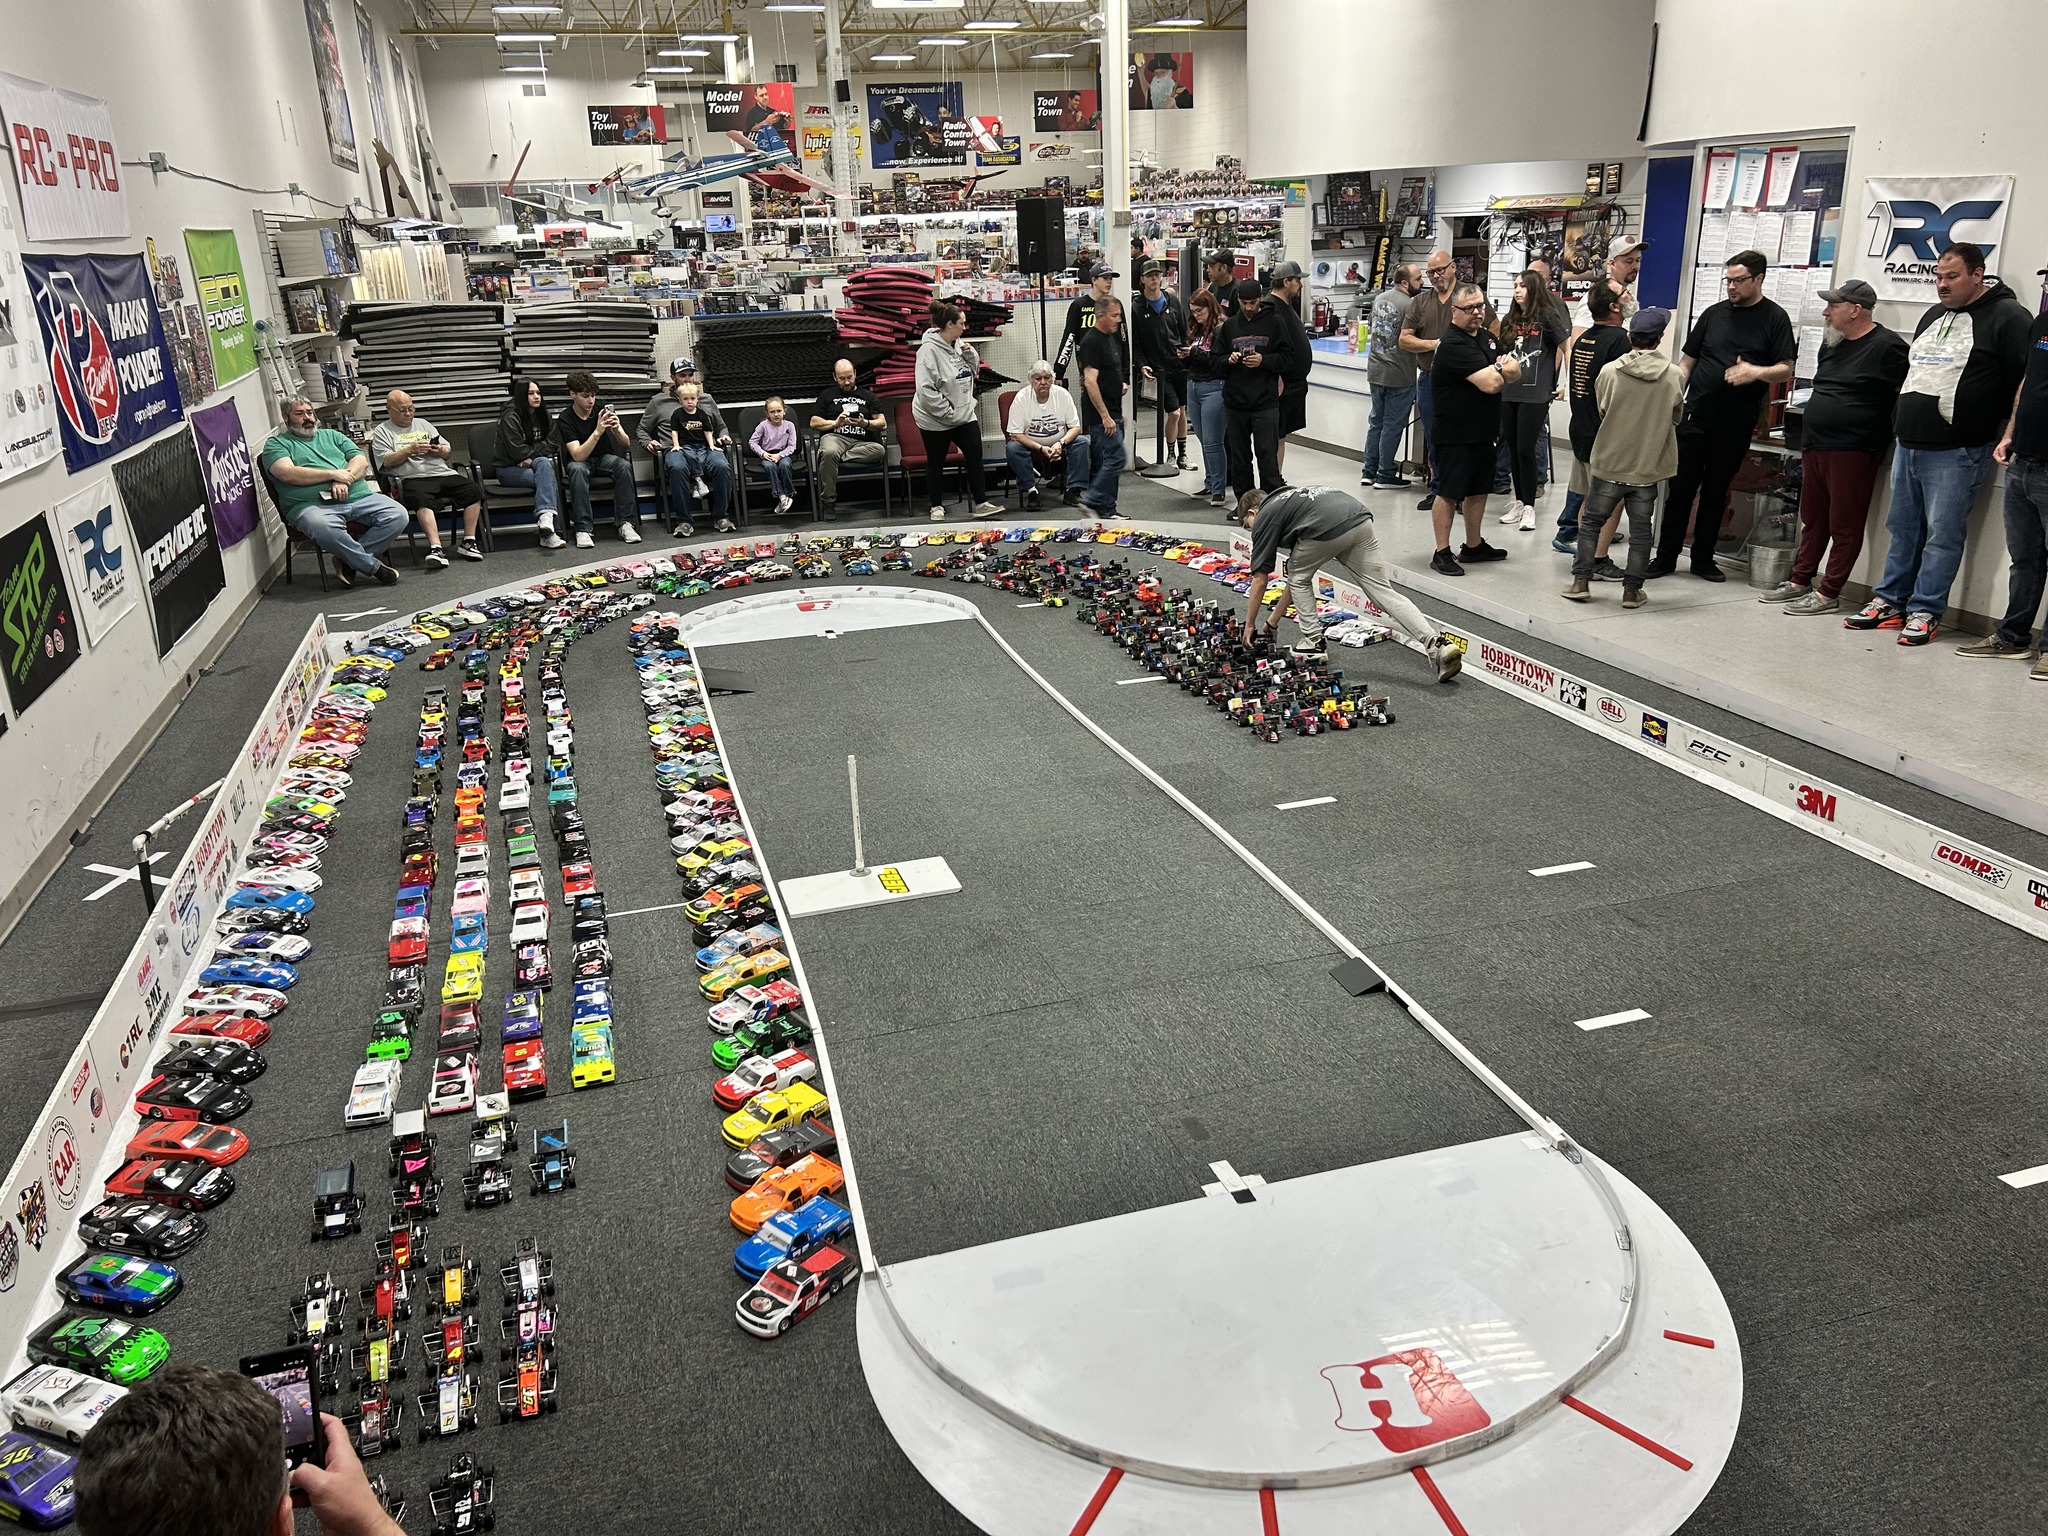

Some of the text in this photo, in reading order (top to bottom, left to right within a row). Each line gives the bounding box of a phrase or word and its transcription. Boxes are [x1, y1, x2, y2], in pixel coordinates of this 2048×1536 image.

[706, 90, 743, 102] Model
[870, 87, 896, 95] You've
[899, 86, 935, 94] Dreamed
[708, 102, 740, 114] Town
[1036, 97, 1058, 107] Tool
[591, 111, 609, 124] Toy
[1038, 106, 1063, 117] Town
[592, 121, 619, 131] Town
[943, 121, 967, 130] Radio
[943, 130, 973, 138] Control
[944, 138, 966, 147] Town
[12, 122, 120, 193] RC-PRO
[909, 157, 953, 165] Experience
[199, 273, 243, 312] ECO
[206, 303, 249, 335] POWER
[1081, 313, 1097, 329] 10
[67, 504, 122, 593] 1RC
[1481, 643, 1555, 688] HOBBYTOWN
[1485, 662, 1548, 694] SPEEDWAY
[1601, 699, 1623, 719] BELL
[1643, 721, 1667, 736] SUNOCO
[1689, 739, 1732, 763] PFC
[1796, 784, 1837, 823] 3M
[195, 804, 228, 875] HOBBYTOWN
[1937, 845, 1992, 875] COMP
[1971, 869, 1998, 884] CAMS
[196, 1072, 214, 1081] 75
[54, 1139, 76, 1187] CAR
[109, 1232, 129, 1246] 3
[447, 1346, 462, 1359] 4
[43, 1376, 73, 1389] 17
[83, 1394, 117, 1419] Mobil
